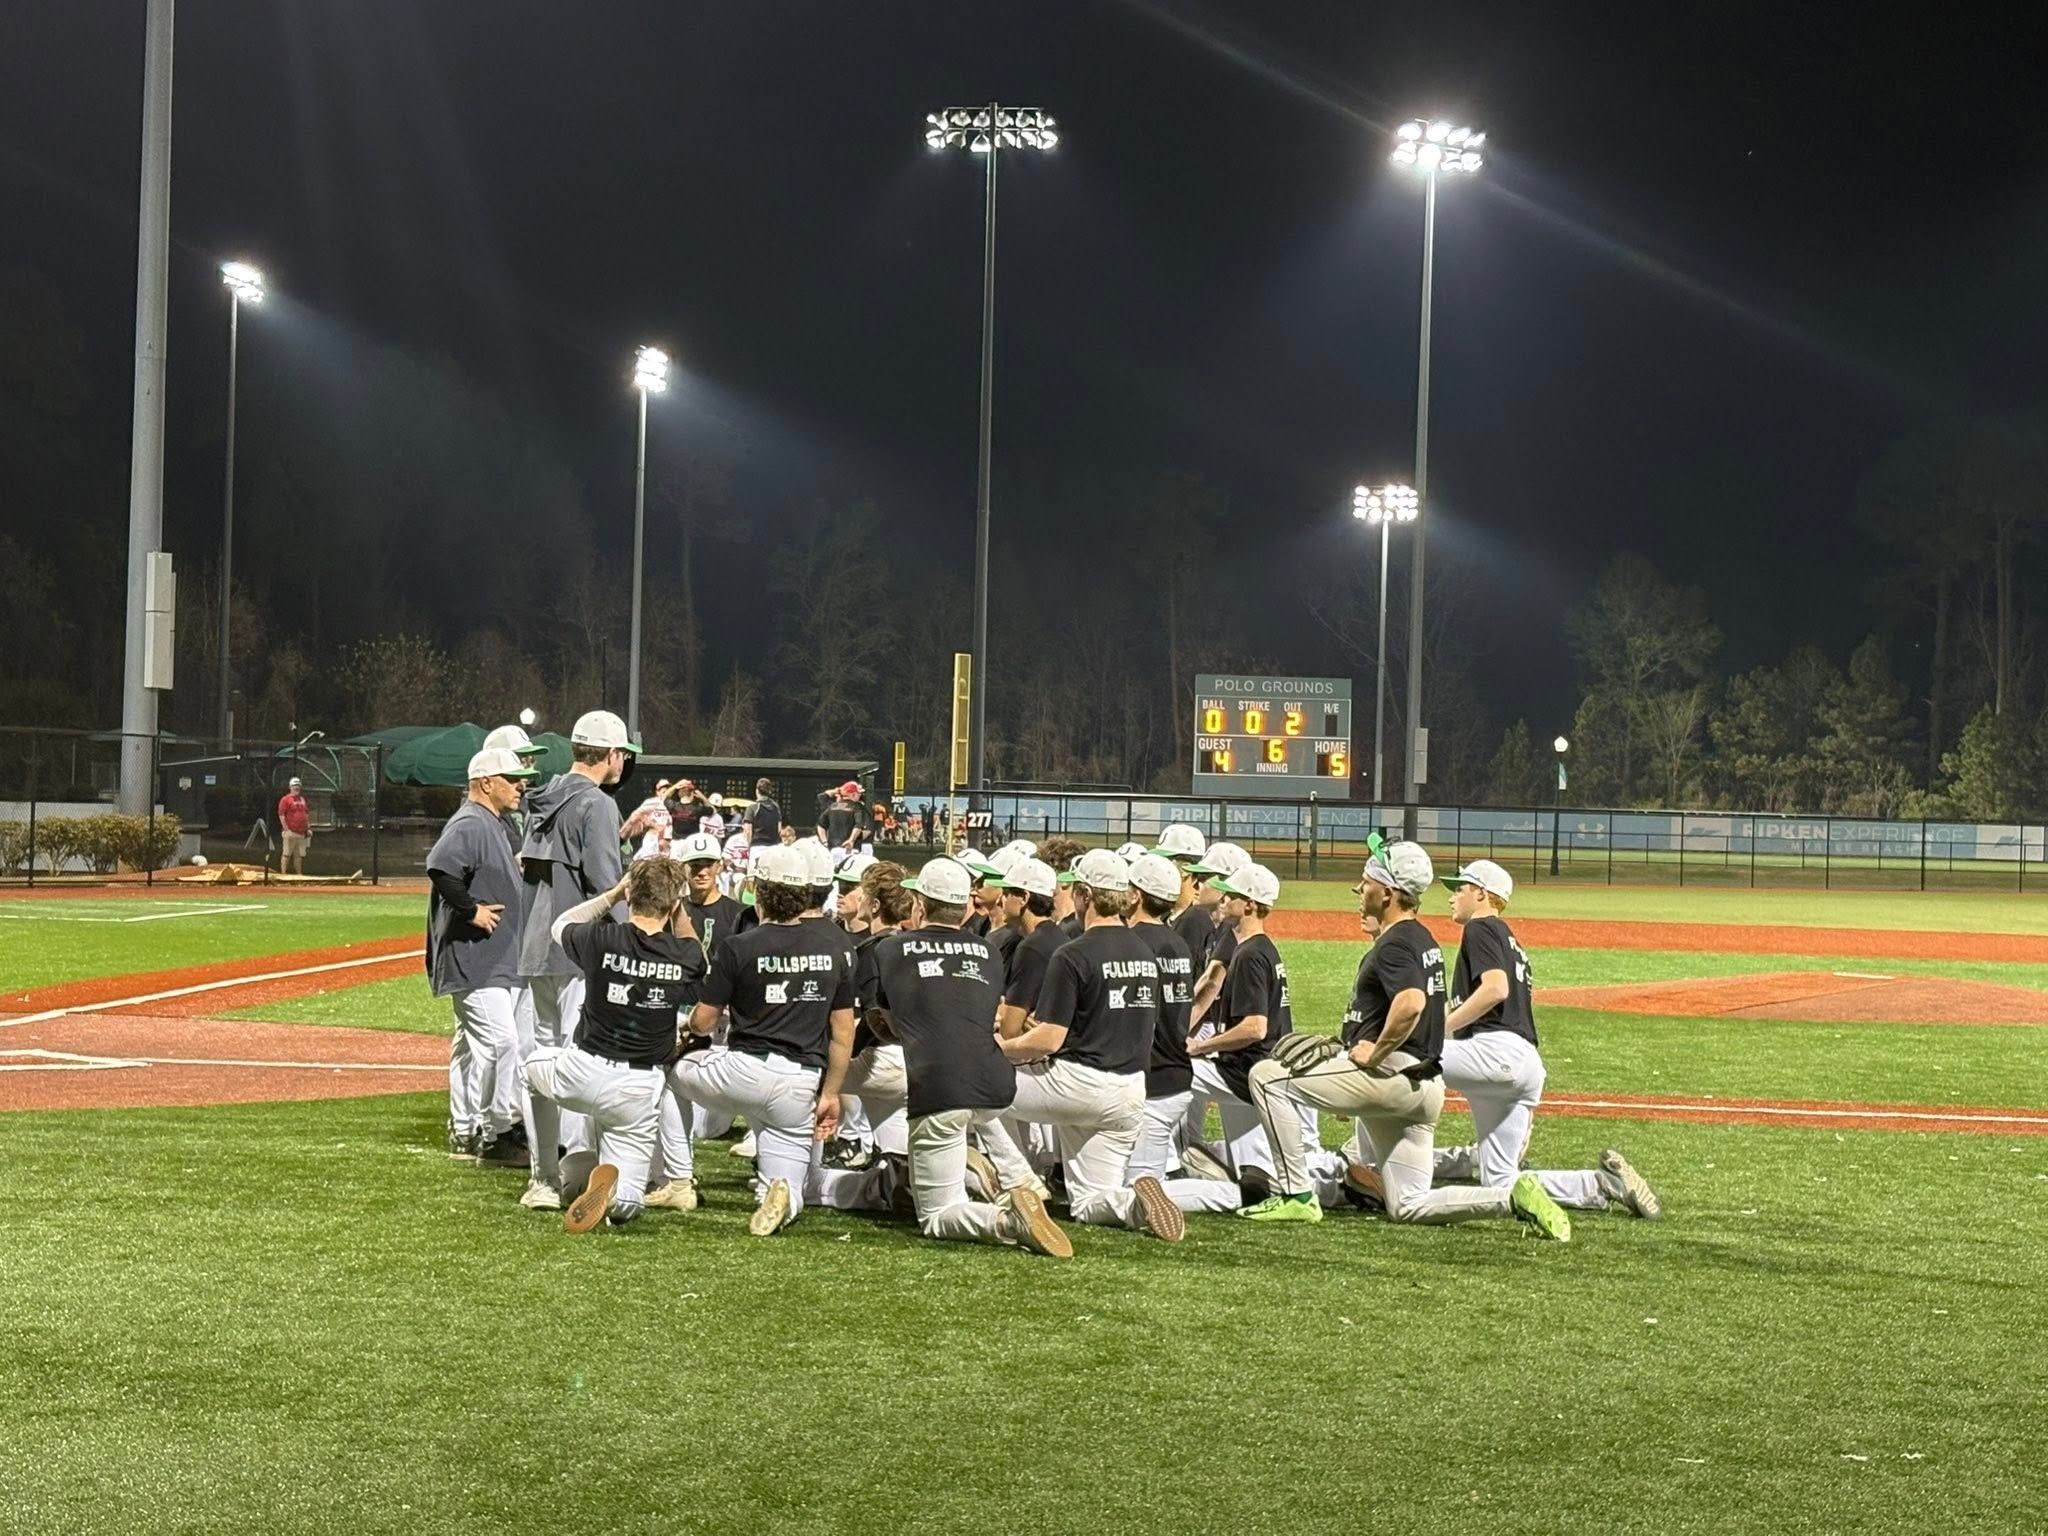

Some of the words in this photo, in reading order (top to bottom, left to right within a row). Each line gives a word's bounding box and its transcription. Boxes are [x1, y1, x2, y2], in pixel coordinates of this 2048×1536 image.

[1214, 679, 1255, 692] POLO
[1261, 681, 1334, 694] GROUNDS
[1202, 700, 1225, 710] BALL
[1238, 701, 1270, 711] STRIKE
[1283, 702, 1302, 712] OUT
[1323, 703, 1340, 713] H/E
[1204, 709, 1224, 733] 0
[1245, 710, 1262, 734] 0
[1285, 711, 1301, 735] 2
[1198, 738, 1232, 750] GUEST
[1267, 738, 1284, 763] 6
[1314, 741, 1346, 753] HOME
[1214, 750, 1231, 773] 4
[1256, 763, 1288, 774] INNING
[1330, 752, 1346, 776] 5
[967, 812, 992, 828] 277
[903, 941, 989, 960] FULLSPEED
[602, 952, 682, 980] FULLSPEED
[757, 955, 833, 974] FULLSPEED
[917, 957, 945, 978] BK
[607, 981, 635, 1006] BK
[765, 980, 790, 1004] BK
